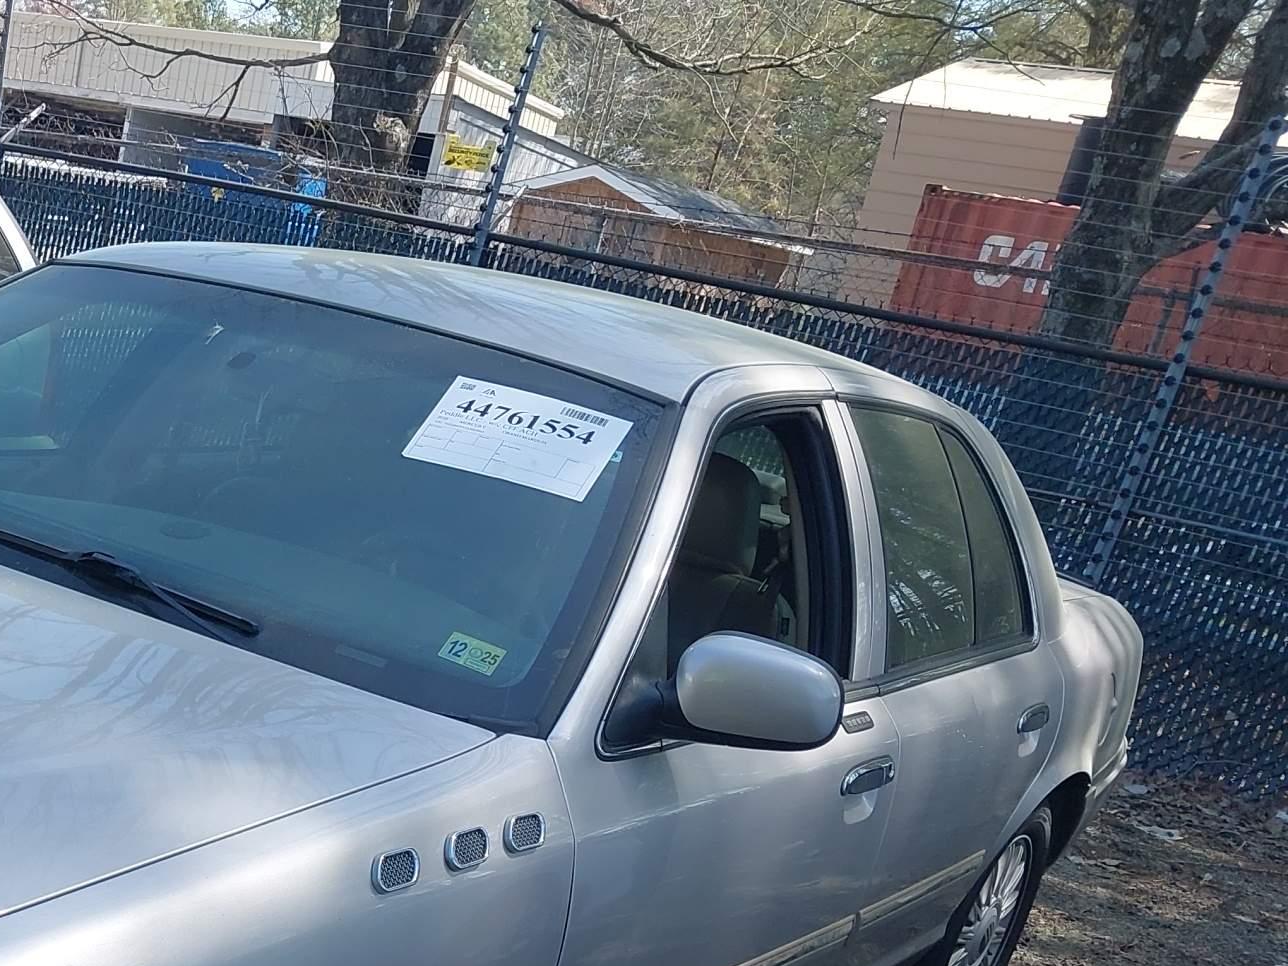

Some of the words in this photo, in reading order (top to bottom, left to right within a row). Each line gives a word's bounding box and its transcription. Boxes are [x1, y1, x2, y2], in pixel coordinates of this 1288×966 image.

[456, 399, 596, 445] 44761554
[448, 640, 468, 657] 12
[481, 651, 500, 666] 25
